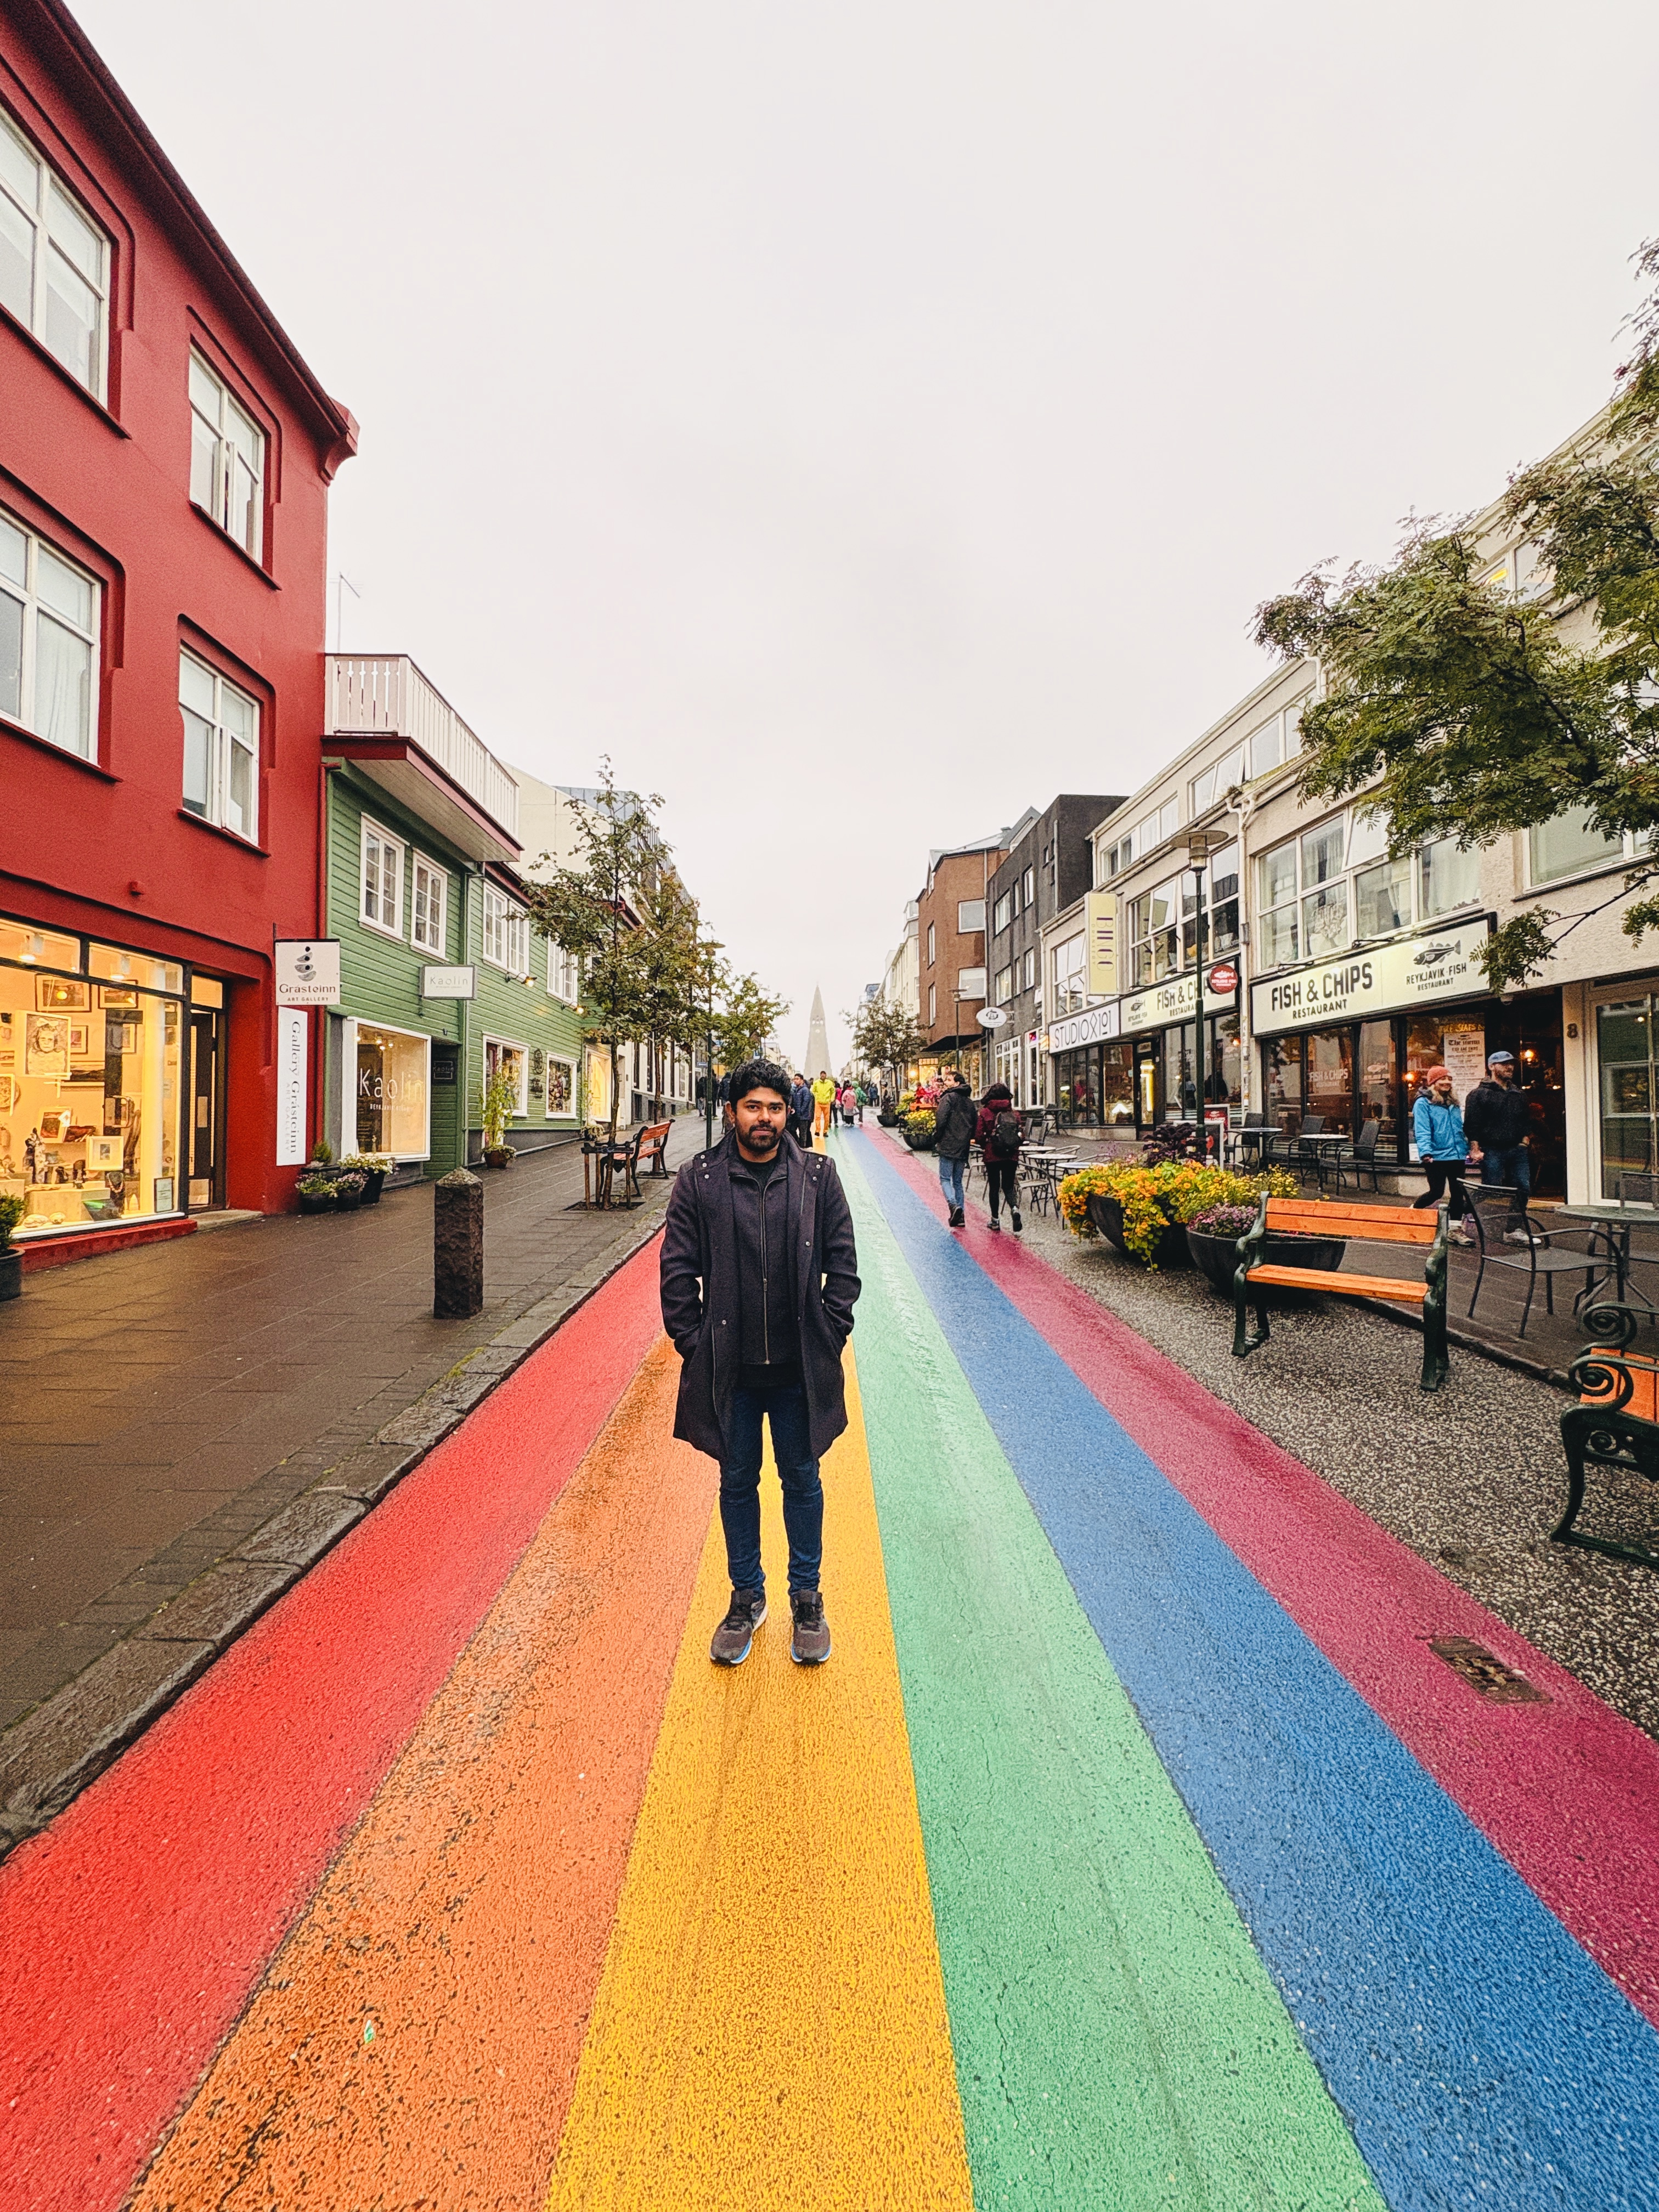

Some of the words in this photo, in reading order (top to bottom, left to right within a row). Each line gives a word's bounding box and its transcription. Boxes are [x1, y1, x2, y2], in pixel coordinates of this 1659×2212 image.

[1096, 917, 1114, 971] BINGO
[430, 977, 468, 985] Kaolin
[1406, 968, 1444, 985] REYKJAVIK
[1448, 962, 1467, 977] FISH
[1418, 978, 1454, 991] RESTAURANT
[1157, 990, 1175, 1011] FISH
[1178, 986, 1185, 1004] &
[1272, 981, 1301, 1011] FISH
[1307, 979, 1319, 1002] &
[1323, 962, 1372, 998] CHIPS
[1293, 999, 1347, 1019] RESTAURANT
[1567, 1023, 1578, 1039] 8
[289, 1021, 301, 1076] Gallery
[360, 1068, 423, 1101] Kaolin
